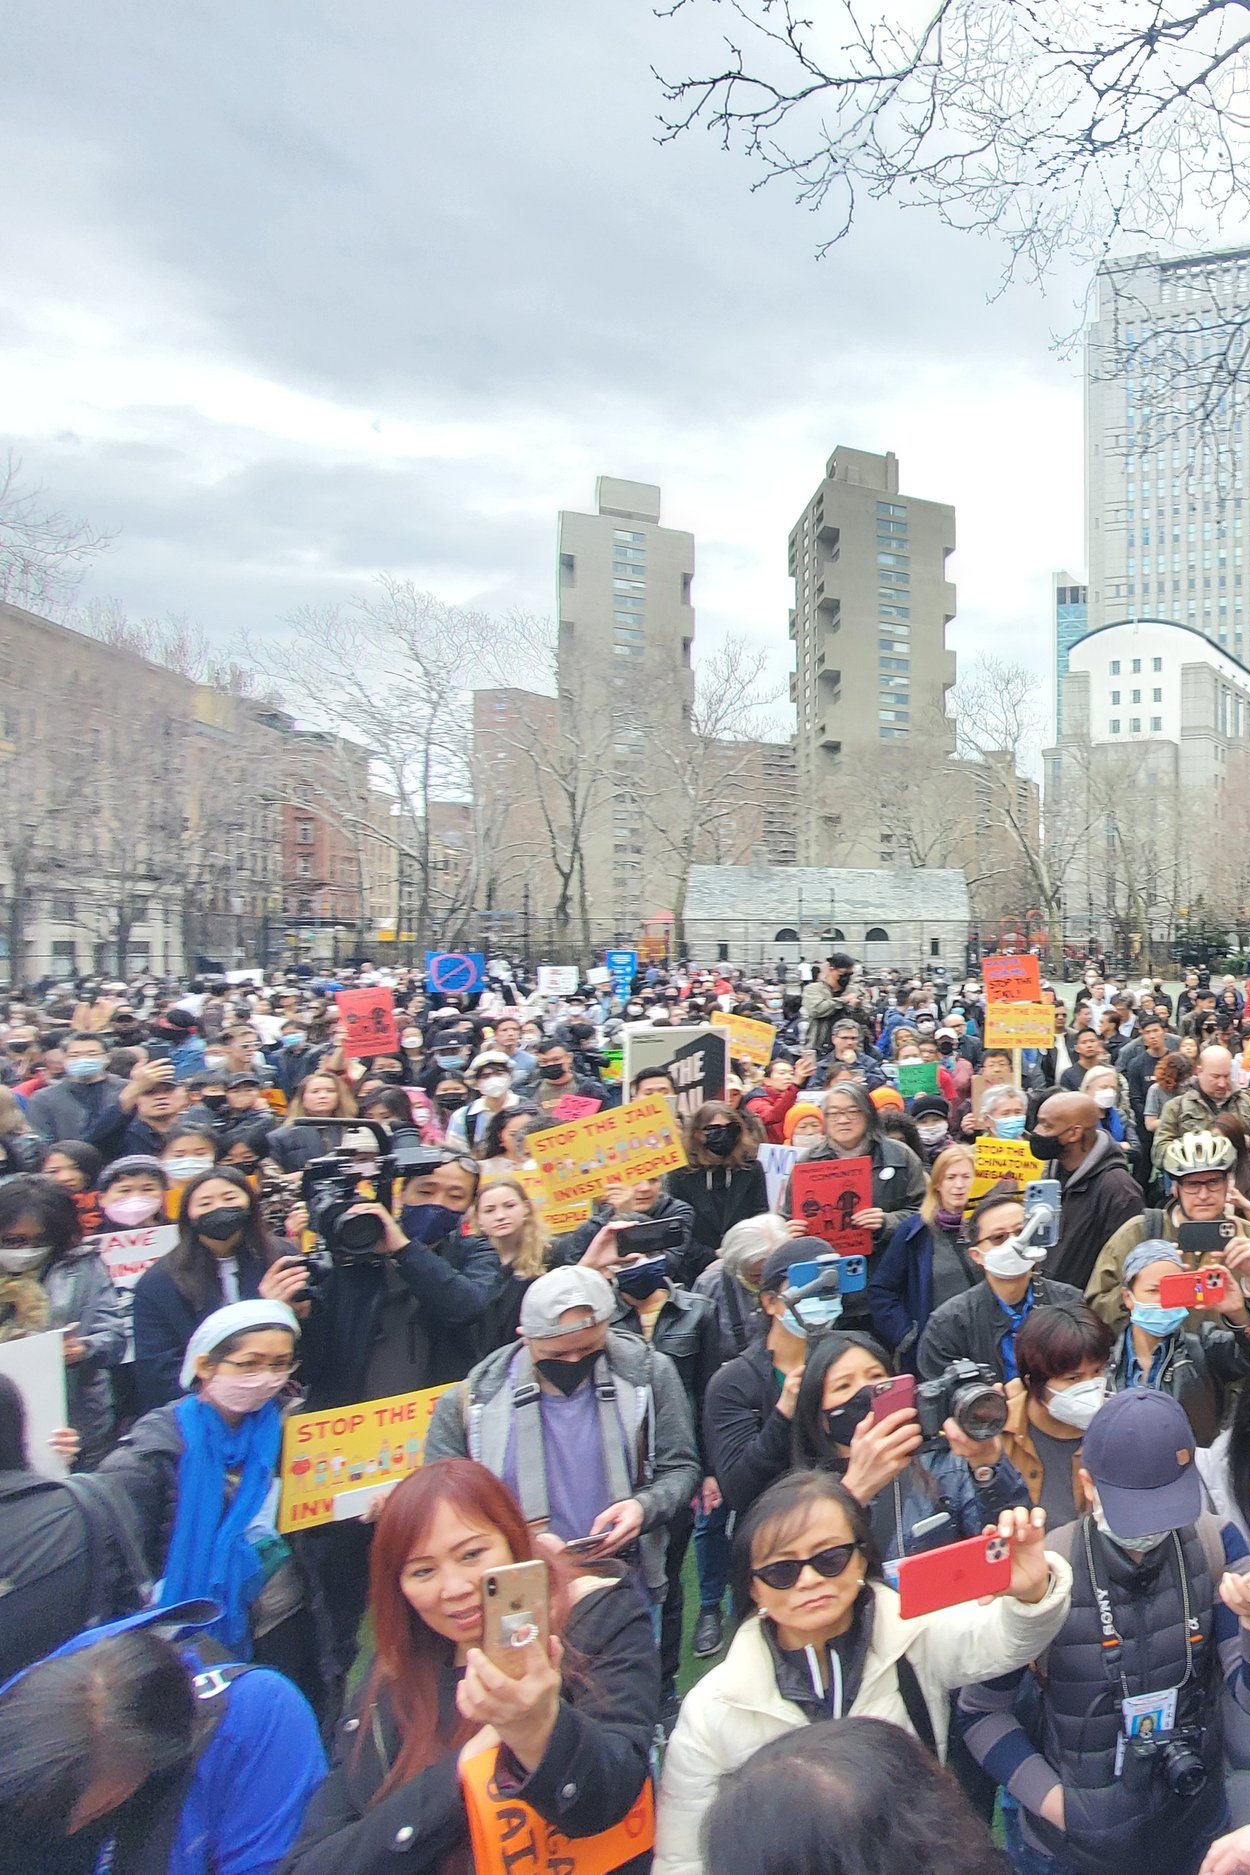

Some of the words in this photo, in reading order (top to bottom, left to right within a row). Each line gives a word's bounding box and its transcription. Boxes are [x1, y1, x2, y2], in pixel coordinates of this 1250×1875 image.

[989, 979, 1010, 989] STOP
[1015, 977, 1032, 985] THE
[990, 1007, 1010, 1015] STOP
[1014, 1007, 1029, 1015] THE
[1033, 1008, 1051, 1016] JAIL
[667, 1050, 706, 1087] THE
[534, 1130, 577, 1152] STOP
[583, 1117, 618, 1137] THE
[624, 1104, 663, 1124] JAIL
[976, 1144, 1004, 1155] STOP
[1006, 1146, 1026, 1157] THE
[976, 1157, 1039, 1170] CHINATOWN
[552, 1178, 602, 1202] INVEST
[605, 1171, 623, 1185] IN
[625, 1151, 680, 1176] PEOPLE
[543, 1209, 588, 1225] PEOPLE
[108, 1229, 159, 1249] AVE
[297, 1414, 365, 1443] STOP
[374, 1402, 417, 1427] THE
[291, 1497, 333, 1521] INV
